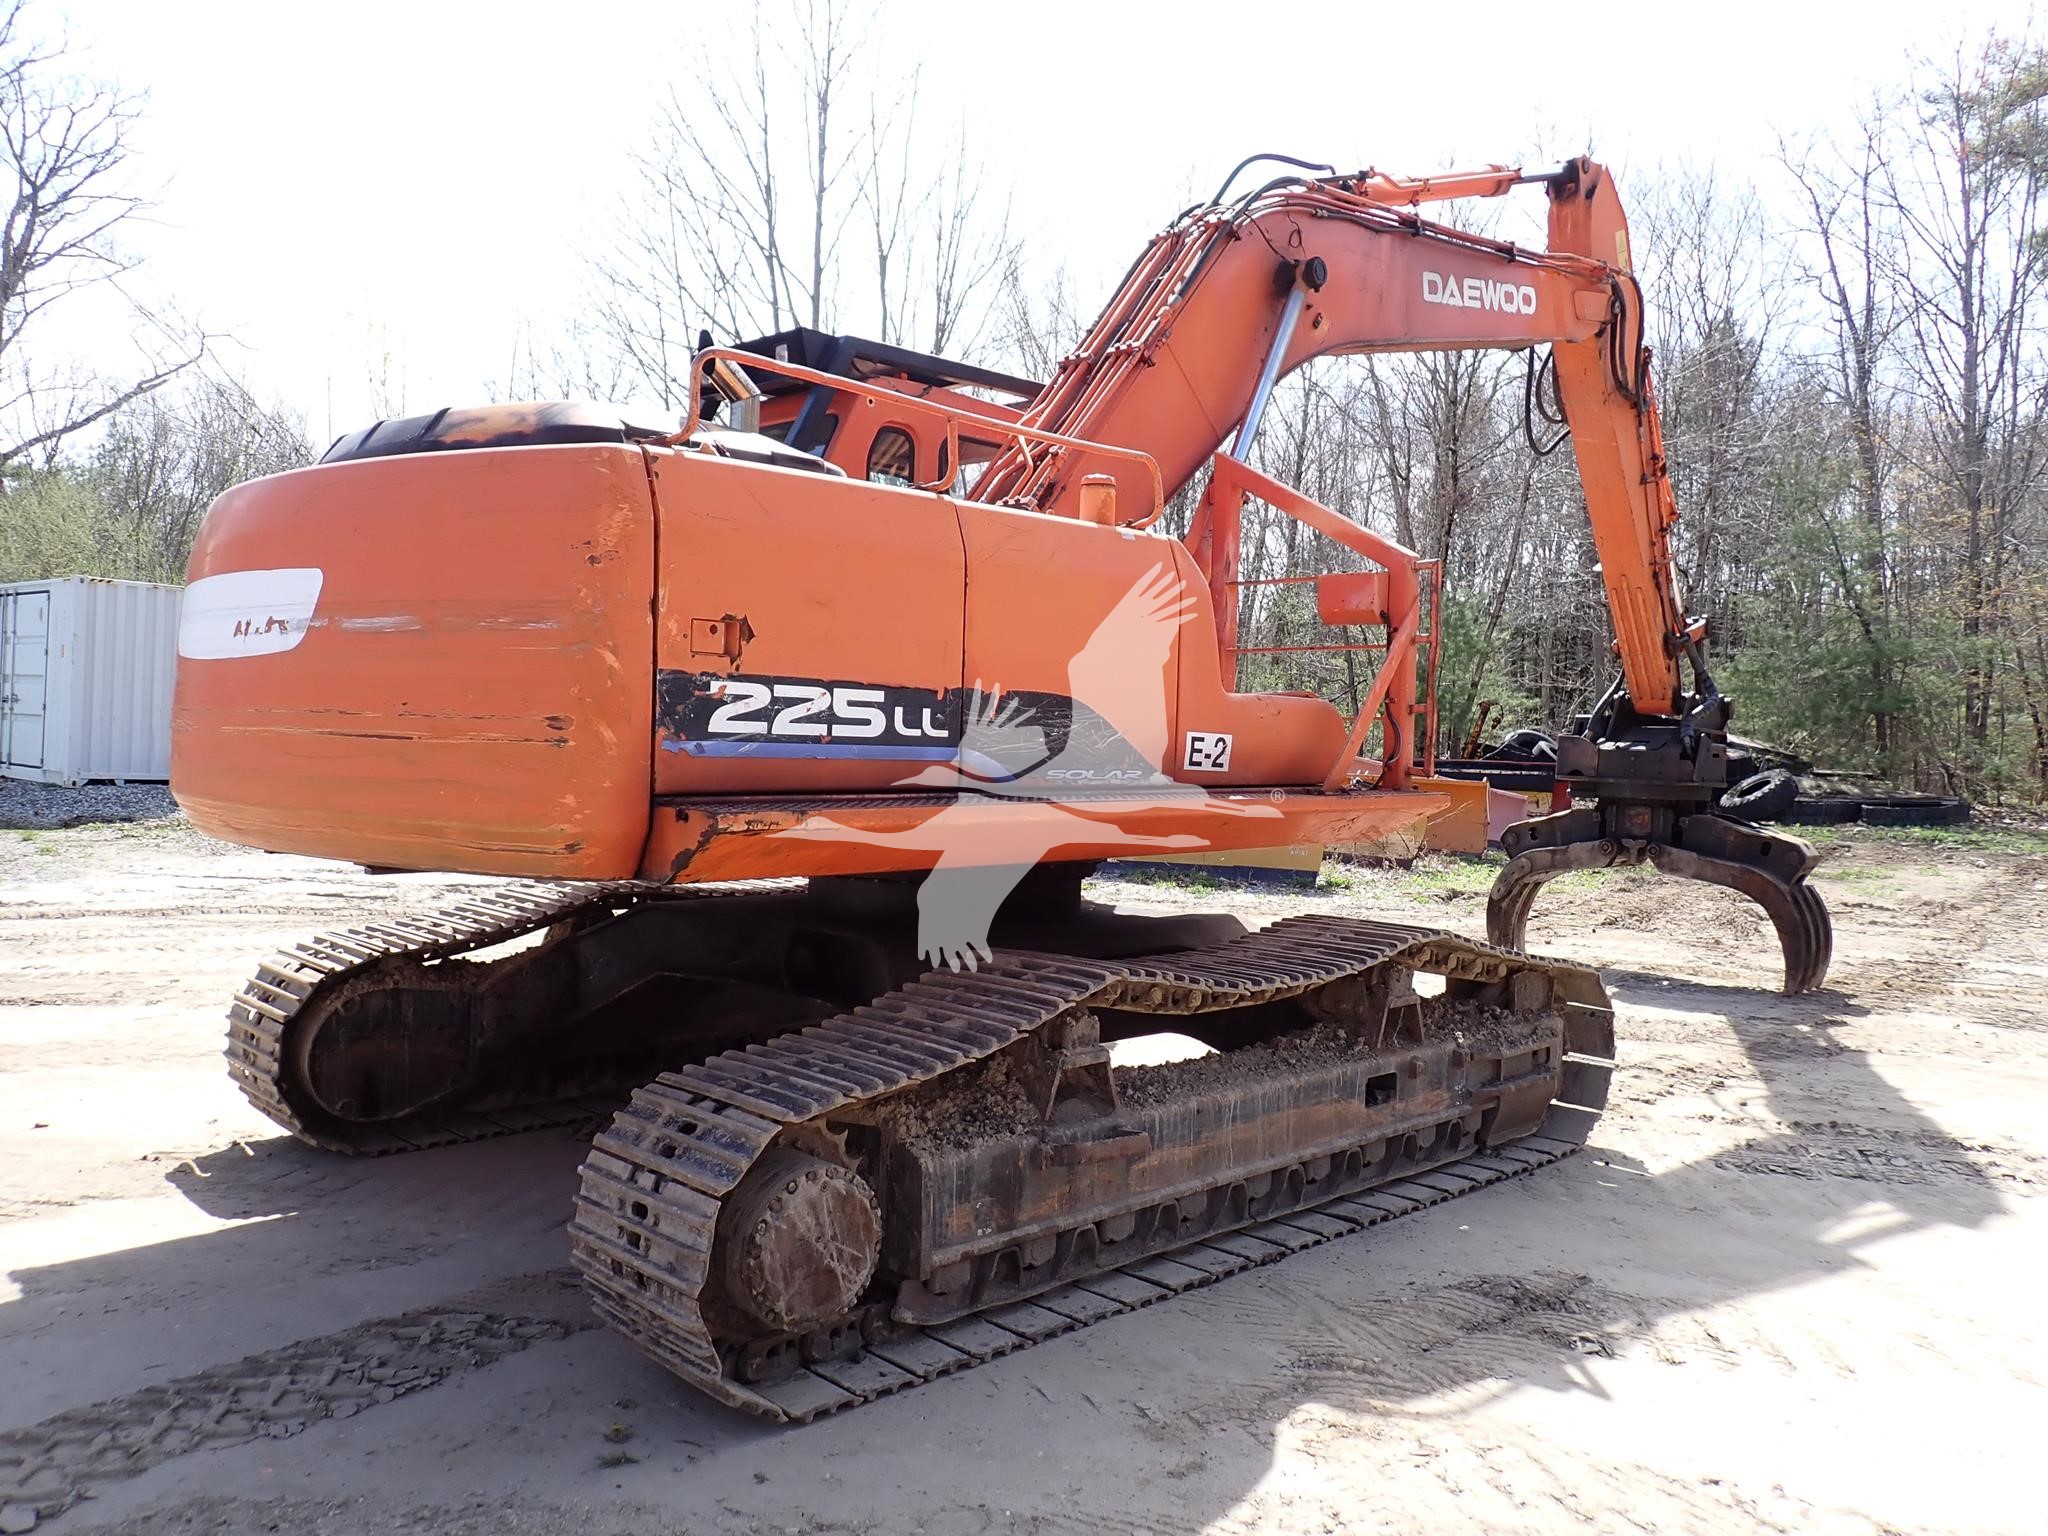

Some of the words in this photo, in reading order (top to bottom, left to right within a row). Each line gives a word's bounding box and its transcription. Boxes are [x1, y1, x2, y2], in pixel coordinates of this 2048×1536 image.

[1422, 271, 1537, 315] DAEWOO
[1188, 736, 1228, 768] E-2
[1046, 769, 1142, 779] SOLAR
